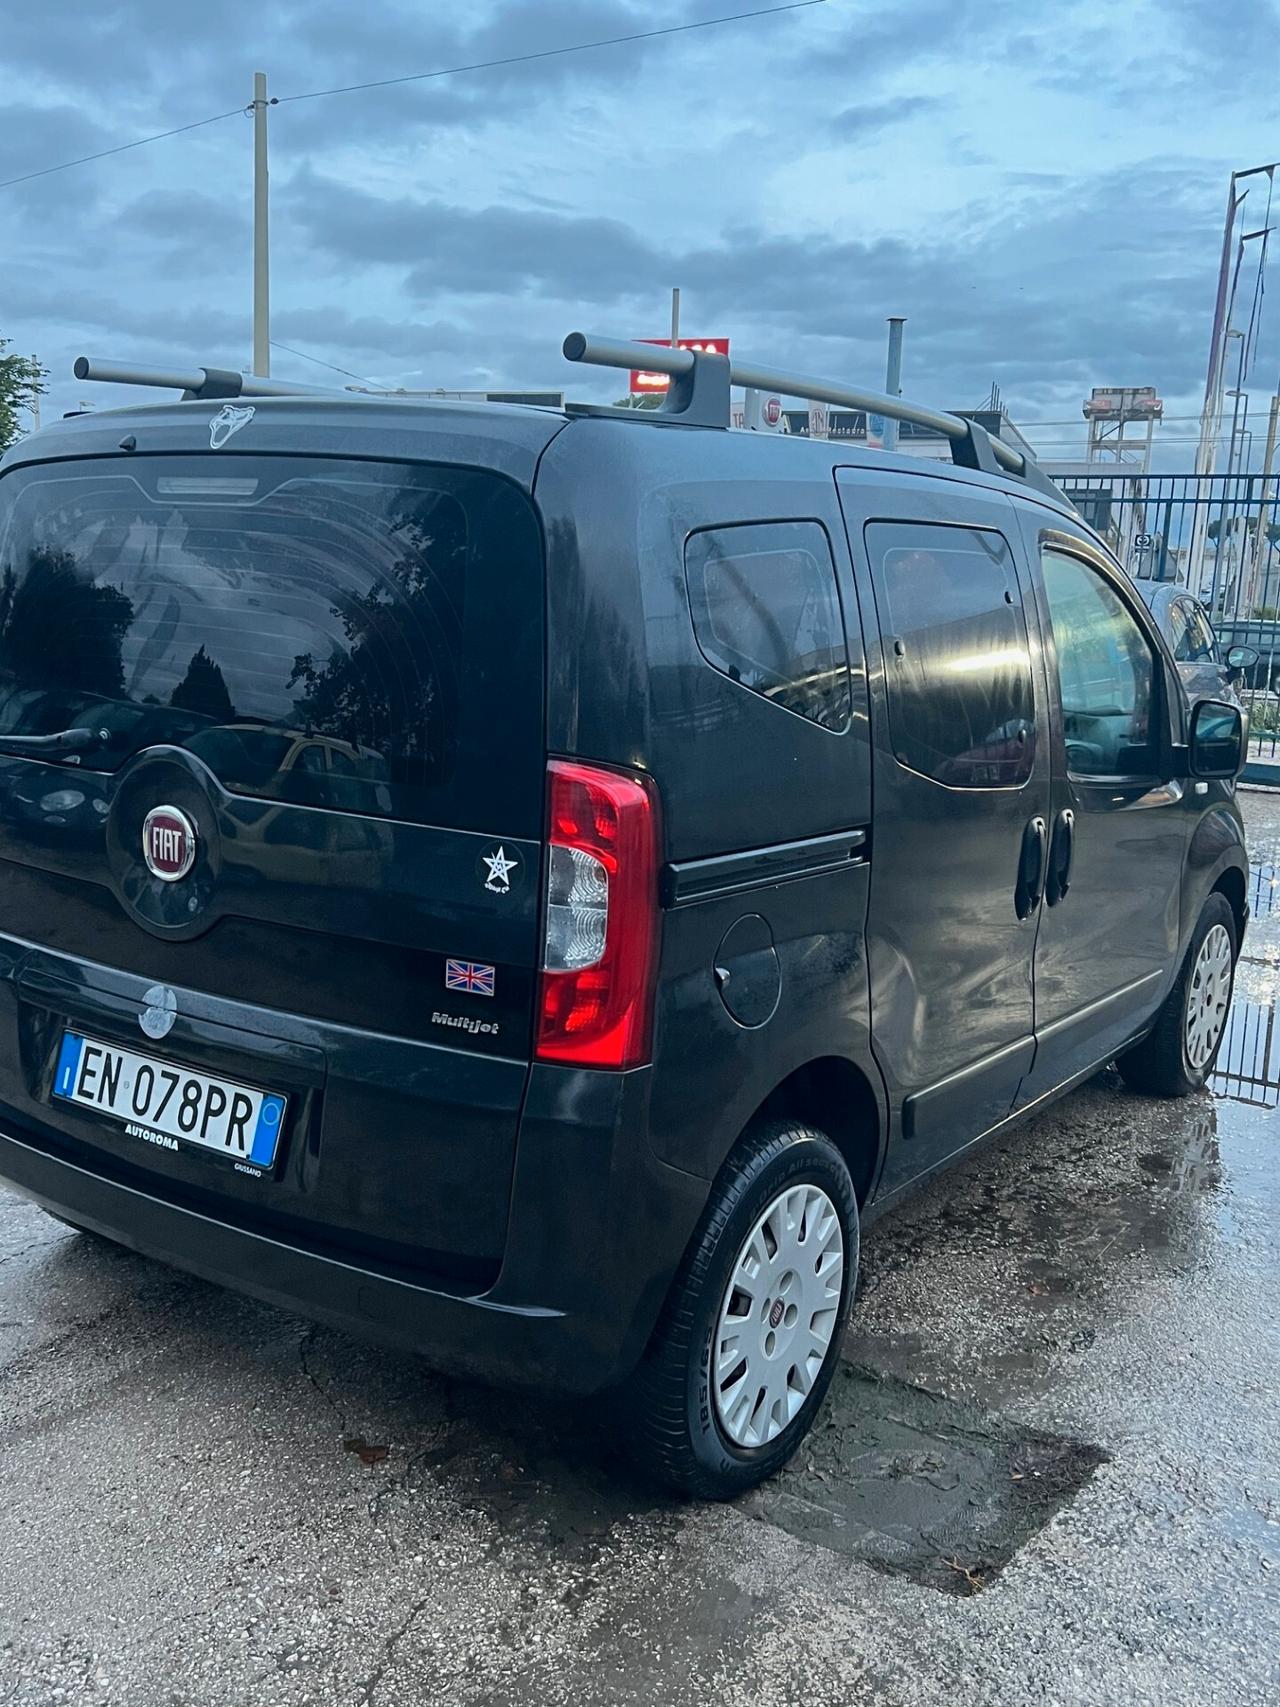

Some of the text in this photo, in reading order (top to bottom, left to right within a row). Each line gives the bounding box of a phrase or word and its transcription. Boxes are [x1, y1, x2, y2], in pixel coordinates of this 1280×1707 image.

[152, 826, 182, 863] FIAT
[77, 1046, 254, 1151] EN 078PR
[124, 1123, 180, 1152] AUTOROMA
